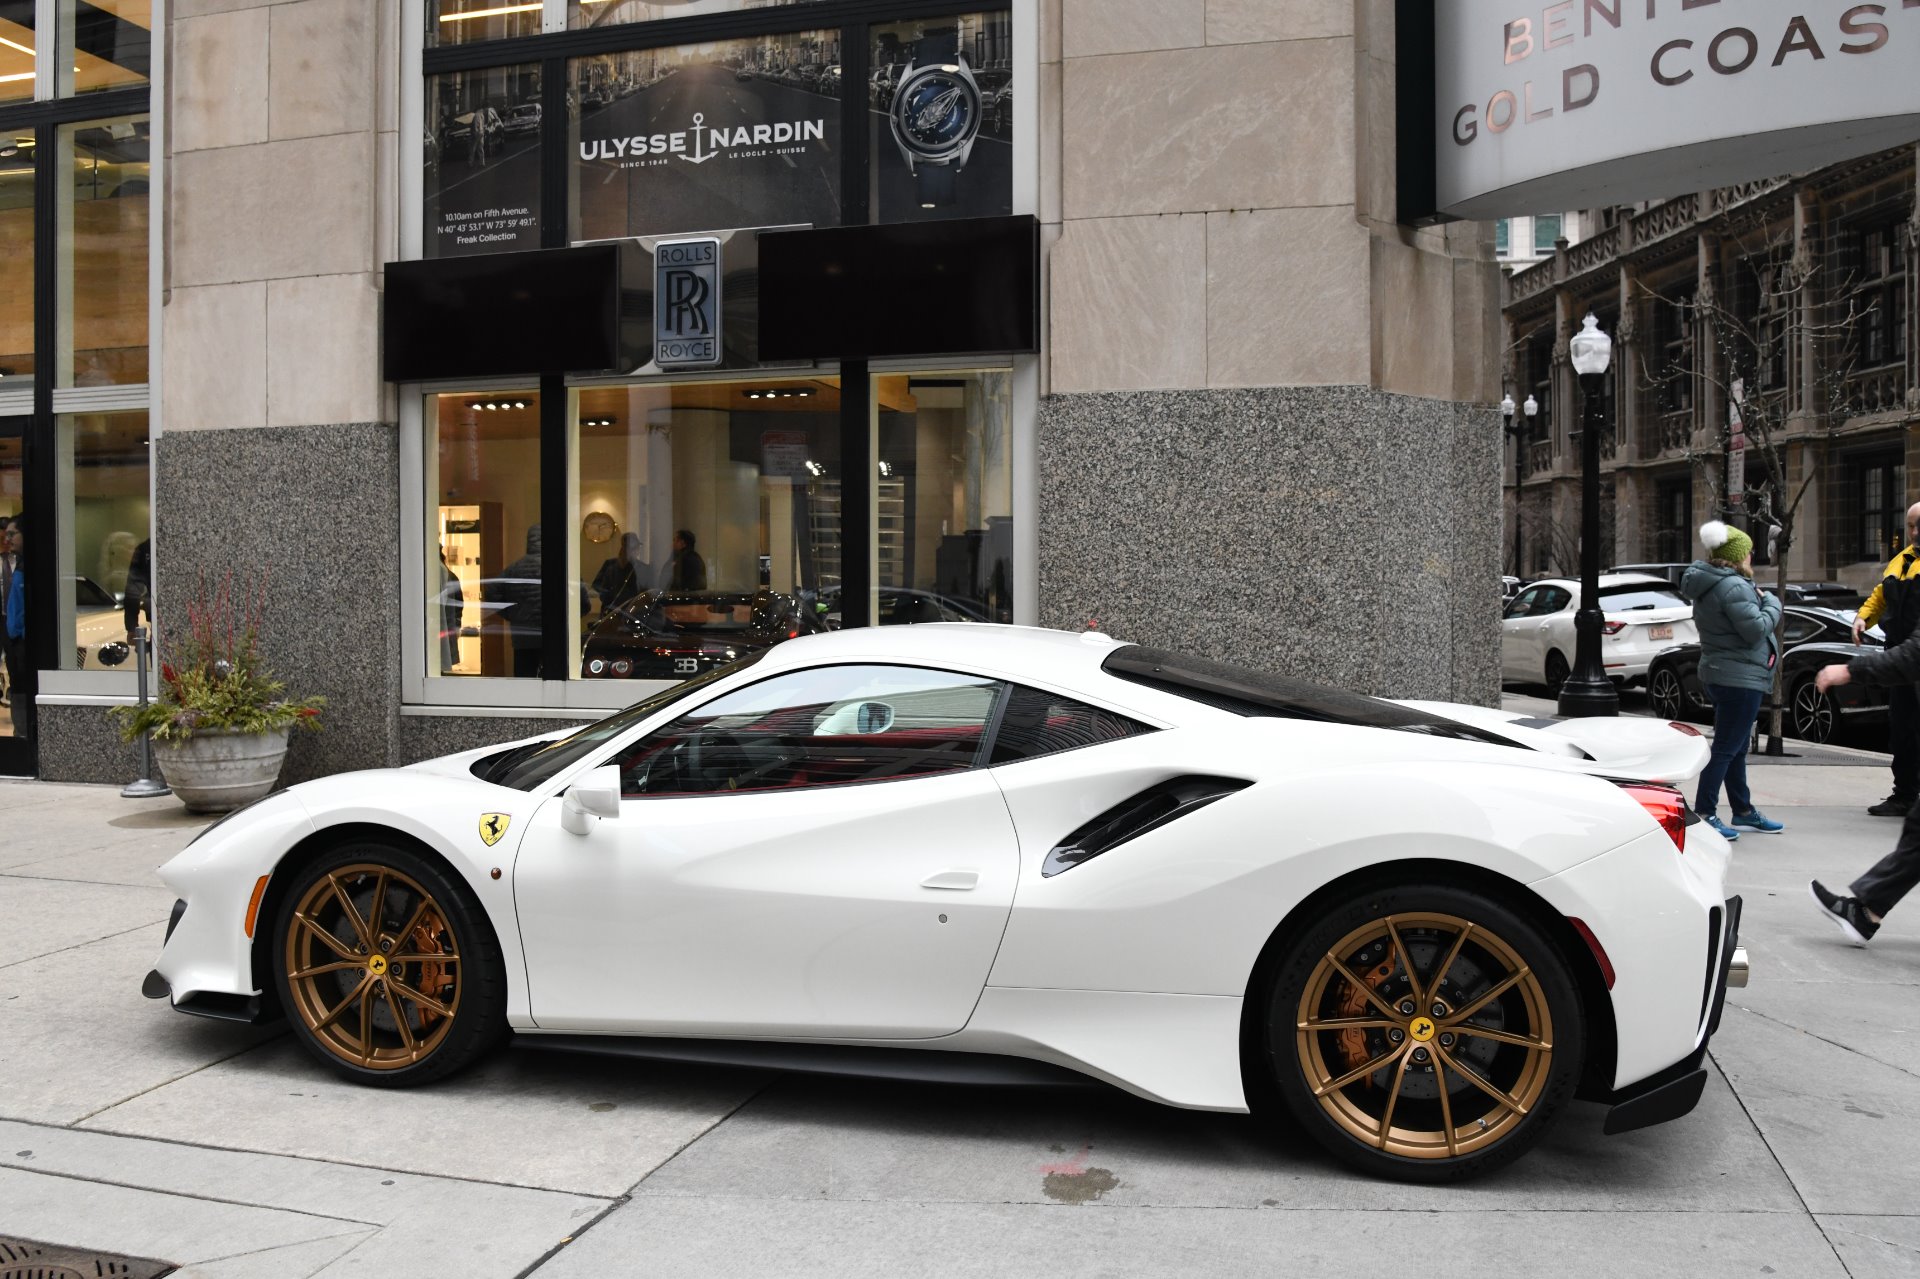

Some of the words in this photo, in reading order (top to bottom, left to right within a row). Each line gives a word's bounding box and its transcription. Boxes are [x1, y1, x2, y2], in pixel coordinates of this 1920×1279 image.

[1504, 0, 1722, 66] BEN
[1452, 62, 1601, 147] GOLD
[1650, 0, 1920, 87] COAS
[580, 131, 687, 161] ULYSSE
[709, 118, 824, 149] NARDIN
[741, 149, 767, 158] LOCLE
[776, 146, 806, 155] SUISSE
[620, 160, 645, 169] SINCE
[445, 212, 472, 222] 10.10am
[473, 211, 483, 219] on
[484, 208, 500, 218] Fifth
[437, 226, 444, 234] N
[486, 221, 494, 230] W
[456, 235, 478, 244] Freak
[478, 232, 517, 242] Collection
[661, 246, 712, 263] ROLLS
[660, 342, 712, 358] ROYCE
